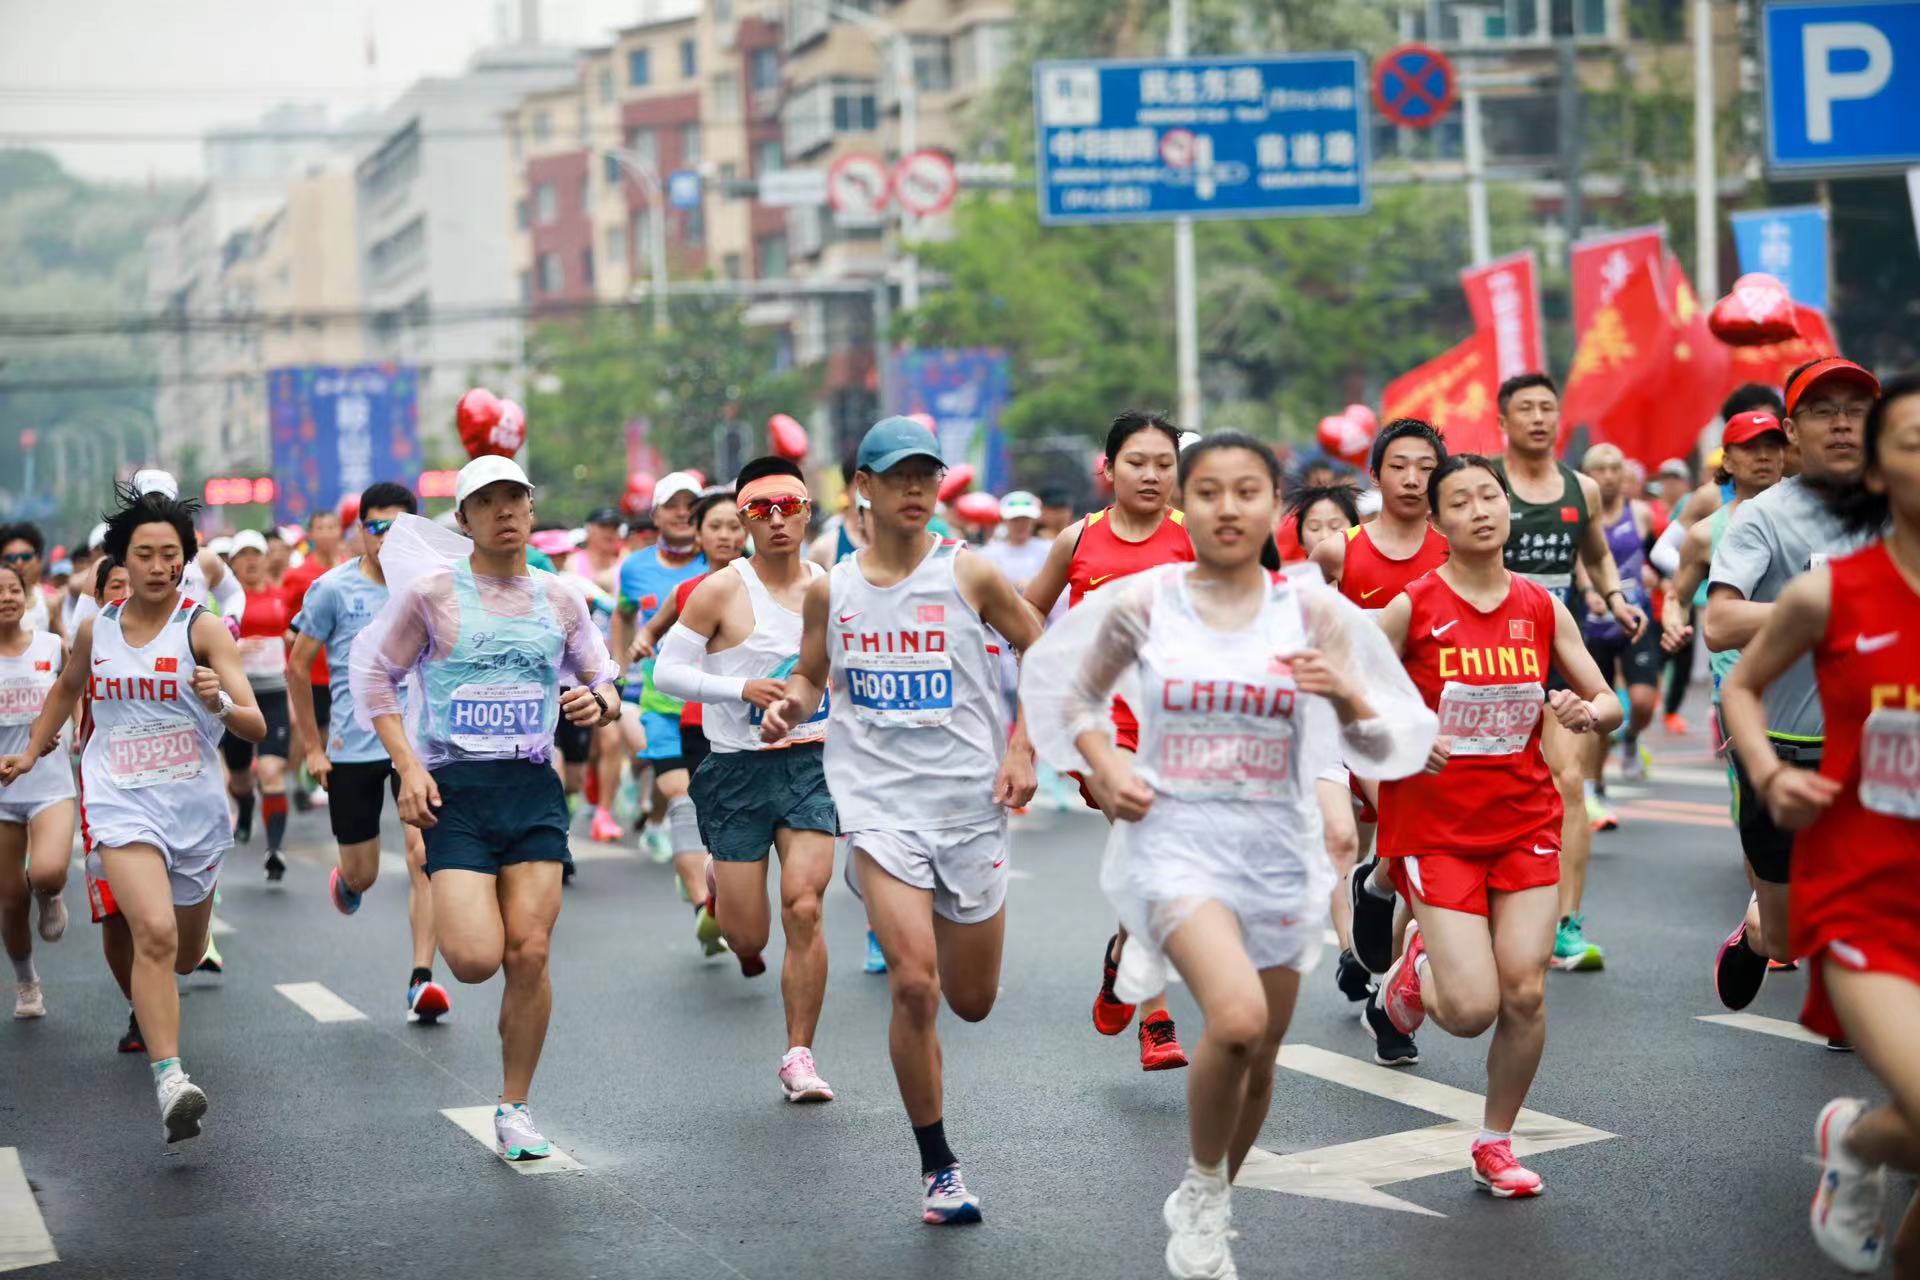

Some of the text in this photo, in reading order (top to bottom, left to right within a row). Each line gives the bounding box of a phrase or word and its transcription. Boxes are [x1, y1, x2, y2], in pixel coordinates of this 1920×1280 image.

[1802, 22, 1893, 144] P
[1438, 646, 1540, 678] CHINA
[91, 676, 178, 702] CHINA
[850, 670, 948, 700] H00110
[1163, 678, 1295, 720] CHINA
[455, 702, 540, 727] H00512
